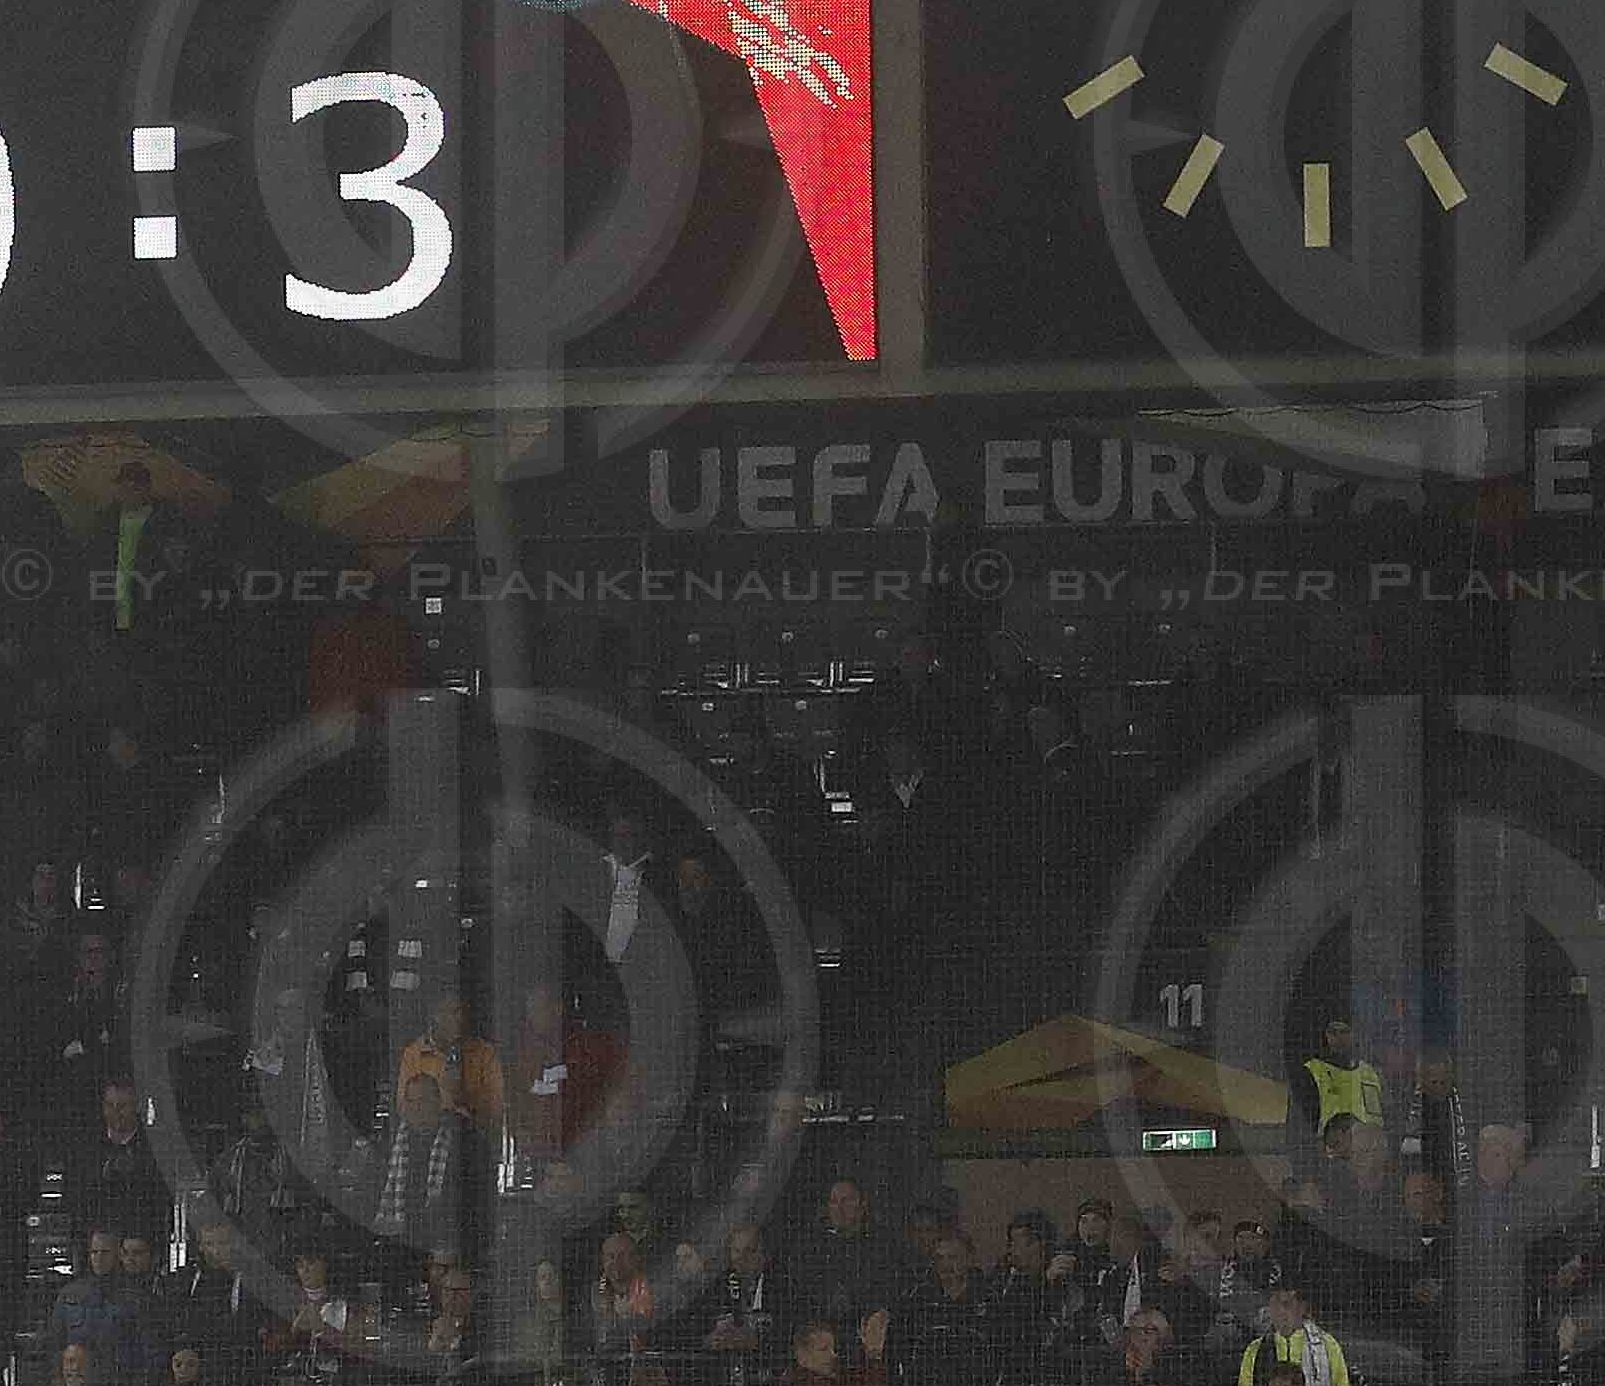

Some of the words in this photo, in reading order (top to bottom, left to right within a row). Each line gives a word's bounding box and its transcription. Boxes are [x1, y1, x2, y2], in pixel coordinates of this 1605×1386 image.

[286, 71, 452, 321] 3
[647, 441, 940, 529] UEFA
[1160, 983, 1203, 1028] 11
